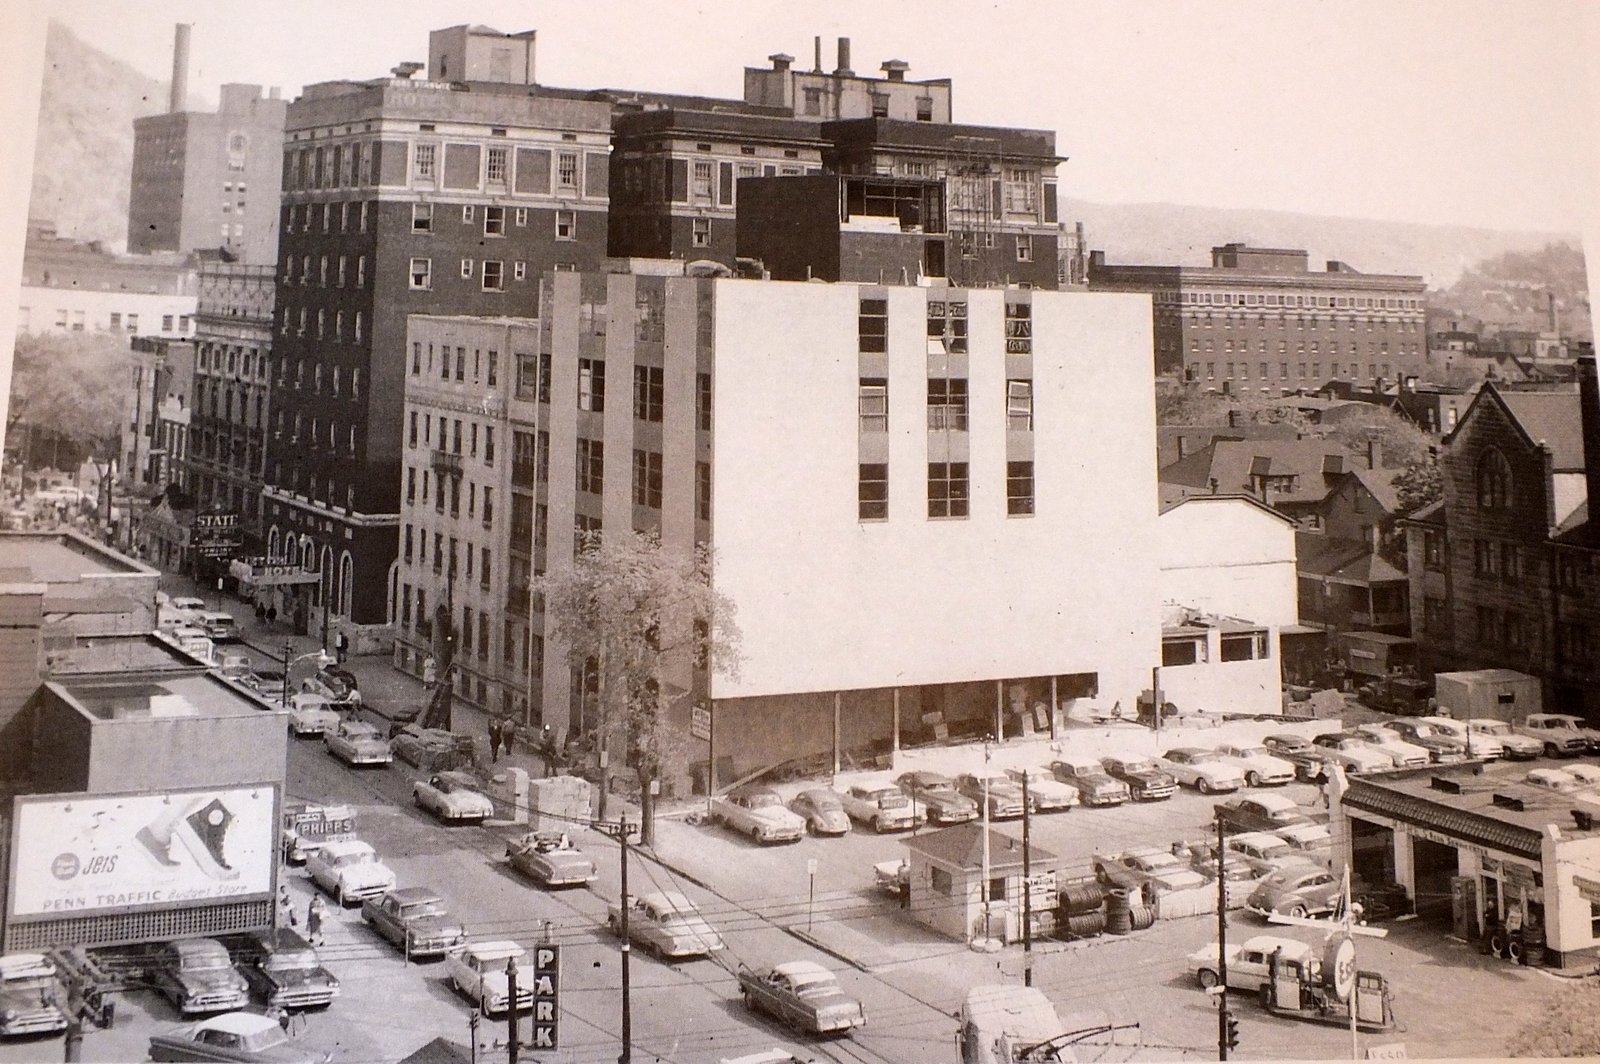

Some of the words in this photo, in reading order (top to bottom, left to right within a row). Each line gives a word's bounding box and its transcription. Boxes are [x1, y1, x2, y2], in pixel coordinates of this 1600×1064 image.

[196, 514, 239, 526] STATE
[301, 820, 352, 836] PHIPPS
[43, 897, 86, 910] PENN
[97, 891, 162, 905] TRAFFIC
[167, 886, 212, 900] Budget
[216, 884, 248, 895] Store
[536, 949, 554, 1048] PARK
